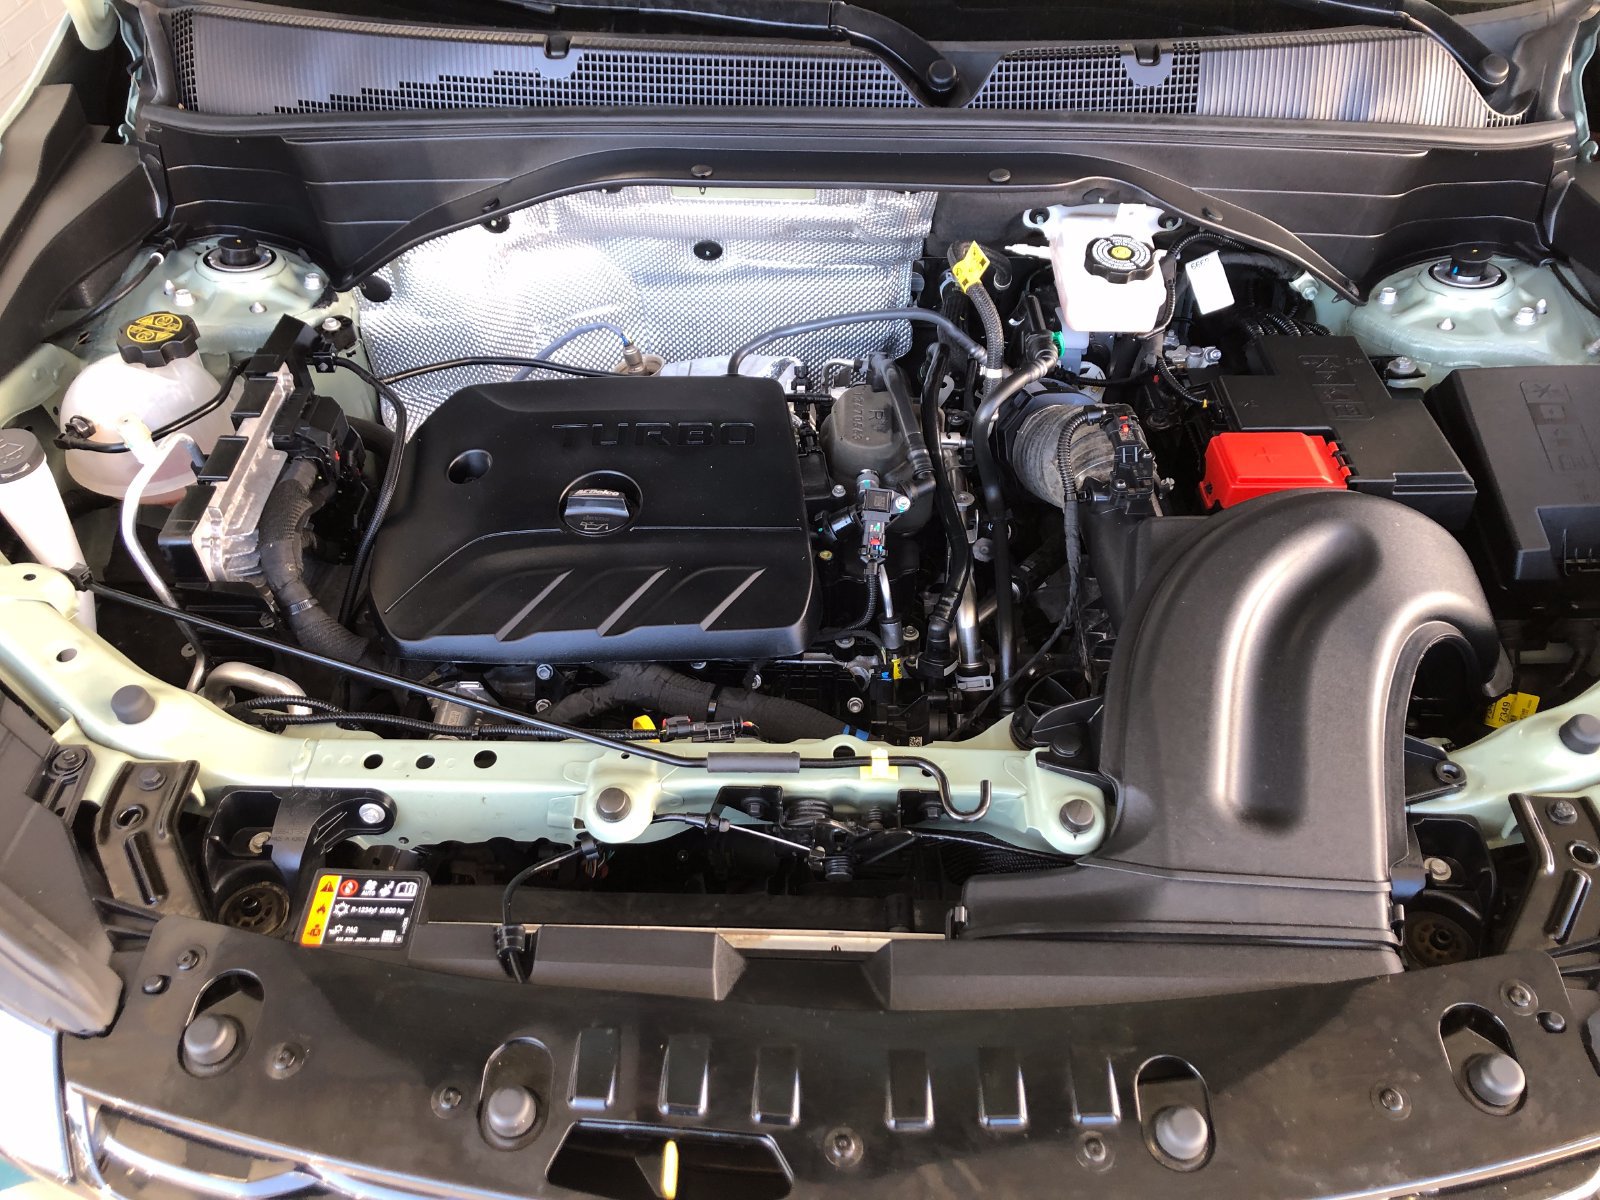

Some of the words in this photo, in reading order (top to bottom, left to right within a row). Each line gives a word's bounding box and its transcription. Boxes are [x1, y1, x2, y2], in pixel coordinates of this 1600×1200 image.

[552, 422, 757, 447] TURBO
[1499, 702, 1511, 722] 7349
[345, 926, 358, 934] PAG
